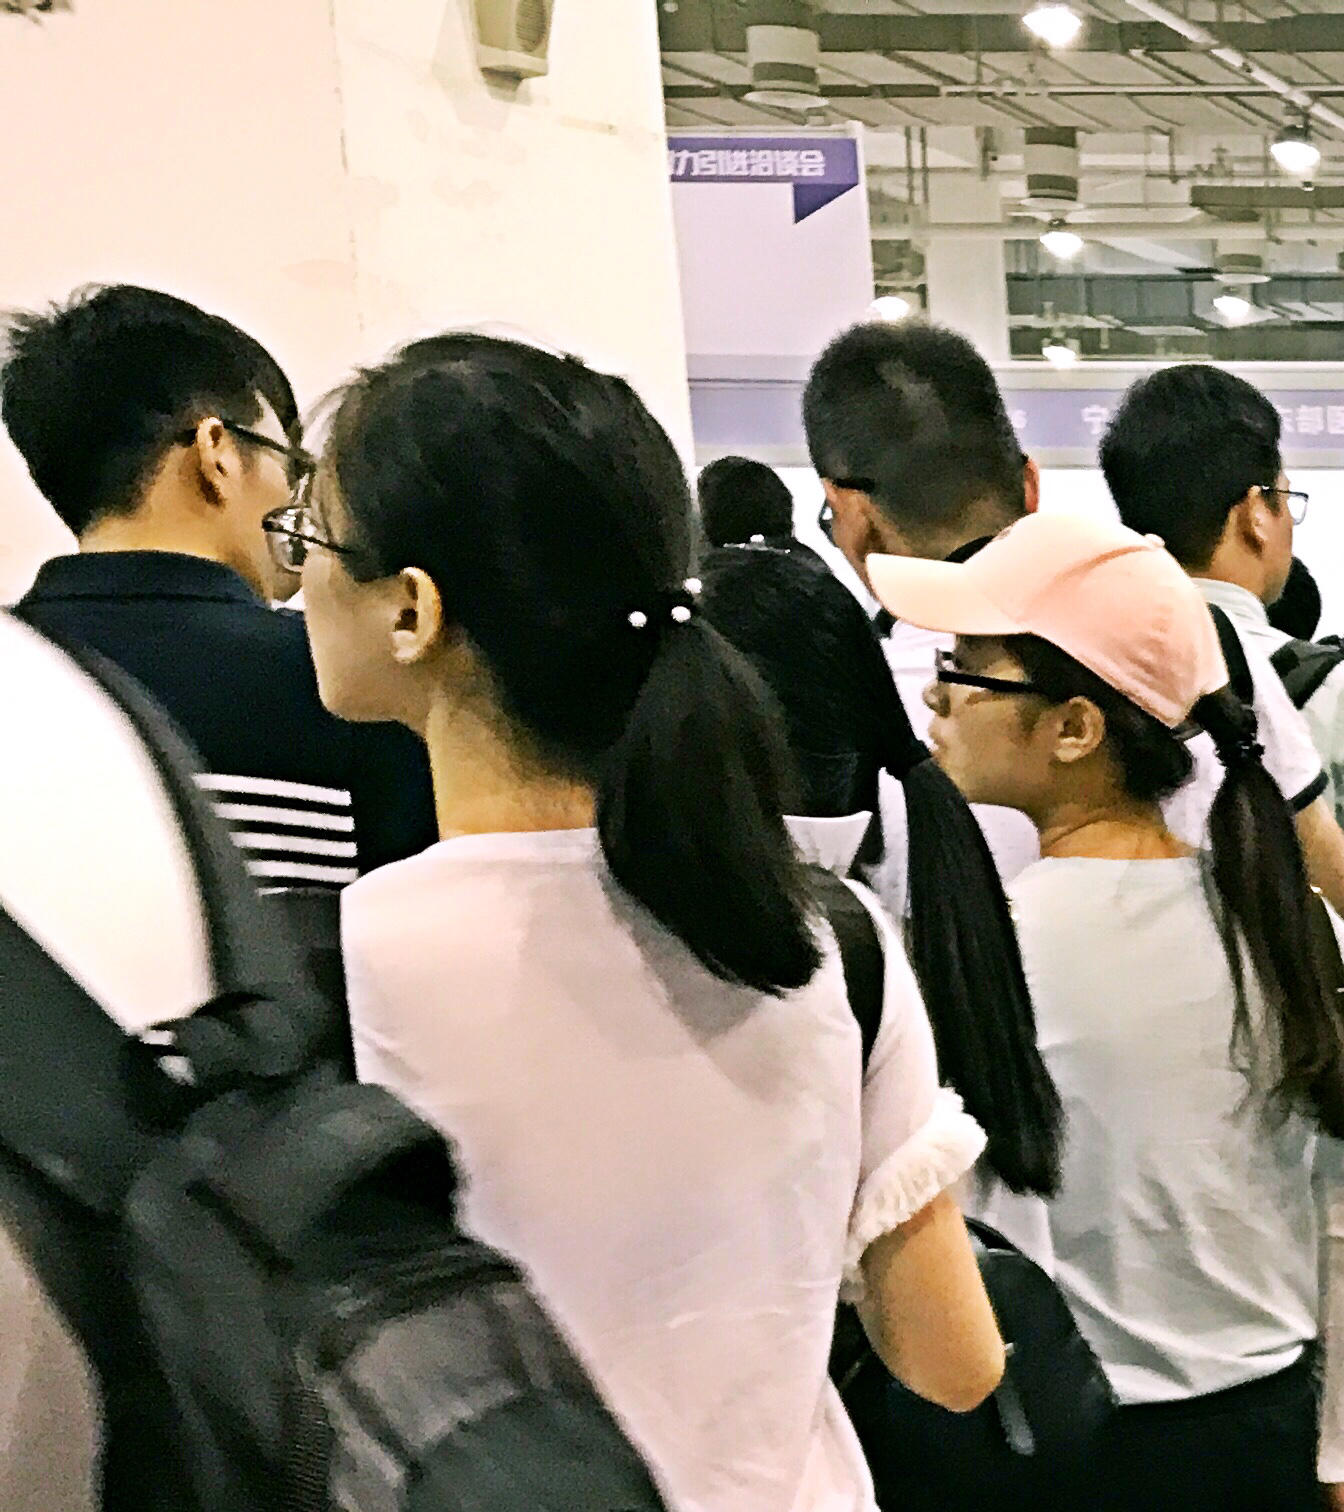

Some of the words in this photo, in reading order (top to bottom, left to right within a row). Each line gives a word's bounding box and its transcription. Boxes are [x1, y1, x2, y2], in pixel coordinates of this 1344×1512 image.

[668, 149, 825, 176] 力引进洽谈会
